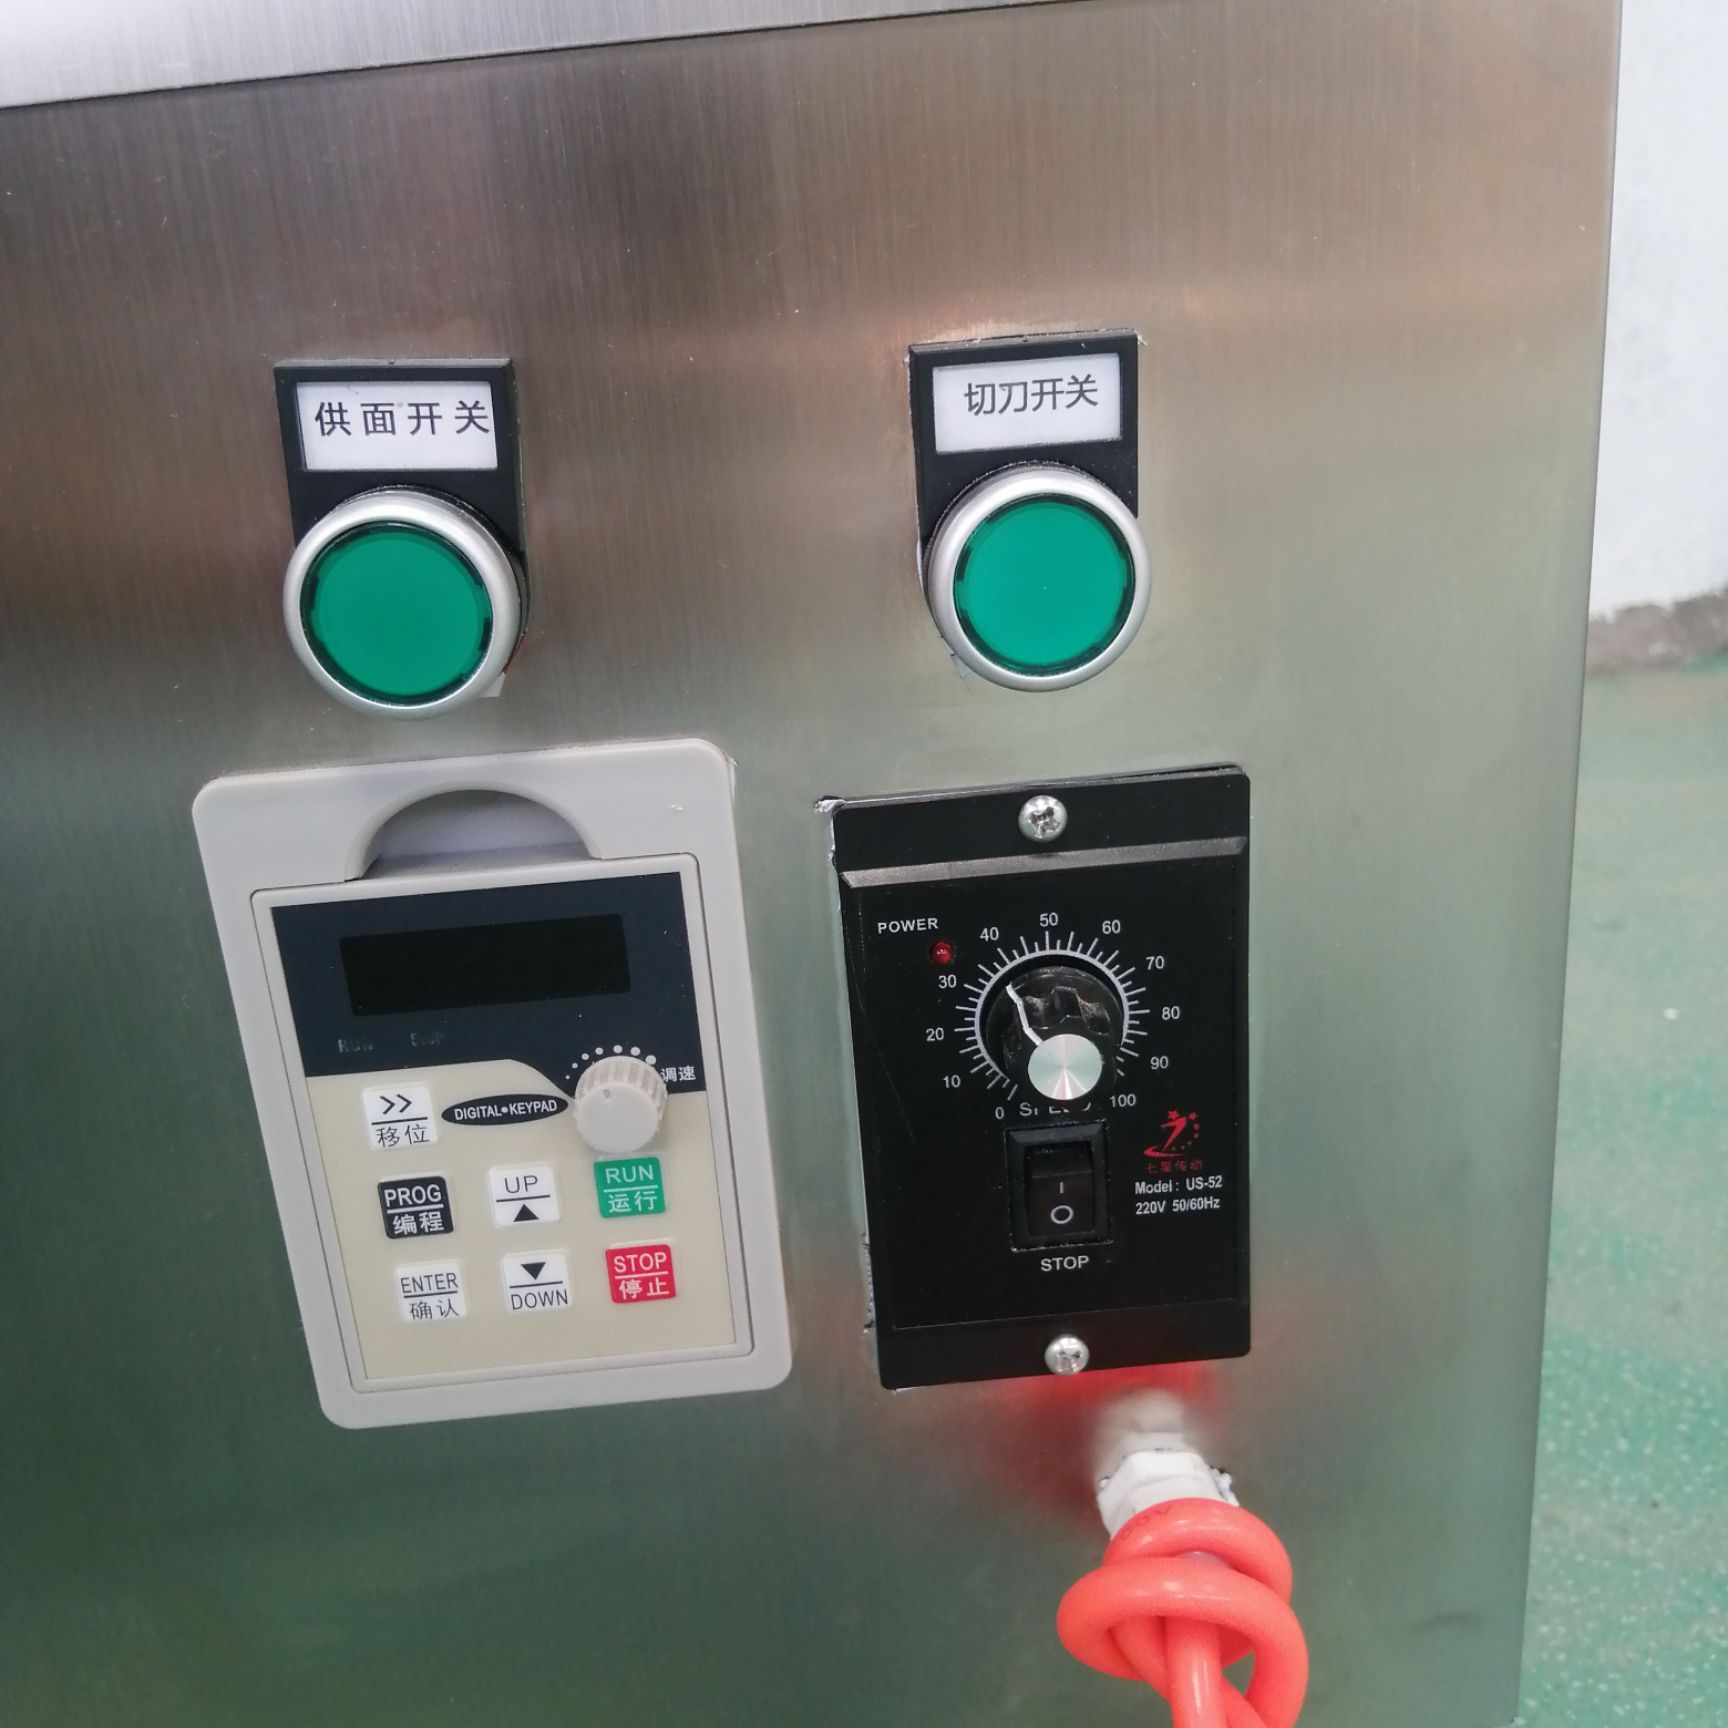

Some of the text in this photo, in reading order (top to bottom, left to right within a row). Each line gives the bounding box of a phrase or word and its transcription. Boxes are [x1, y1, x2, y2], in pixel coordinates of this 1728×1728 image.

[964, 373, 1099, 416] 切刀开关
[314, 400, 490, 437] 供面开关
[877, 917, 939, 934] POWER
[1039, 912, 1059, 928] 50
[1101, 919, 1121, 935] 60
[979, 926, 1000, 942] 40
[1146, 955, 1165, 971] 70
[938, 974, 957, 990] 30
[1161, 1005, 1181, 1021] 80
[925, 1027, 945, 1043] 20
[1150, 1055, 1169, 1071] 90
[660, 1065, 697, 1082] 调速
[943, 1074, 961, 1090] 10
[1109, 1093, 1137, 1108] 100
[995, 1106, 1005, 1120] 0
[376, 1124, 430, 1148] 移位
[605, 1164, 655, 1184] RUN
[504, 1175, 539, 1194] UP
[1185, 1175, 1223, 1191] US-52
[384, 1184, 442, 1207] PROG
[607, 1189, 658, 1213] 运行
[1135, 1196, 1221, 1215] 220V 50/60Hz
[392, 1211, 445, 1236] 编程
[613, 1251, 667, 1273] STOP
[1040, 1255, 1089, 1272] STOP
[400, 1272, 458, 1295] ENTER
[618, 1278, 670, 1300] 停止
[510, 1289, 568, 1311] DOWN
[409, 1298, 460, 1321] 确认
